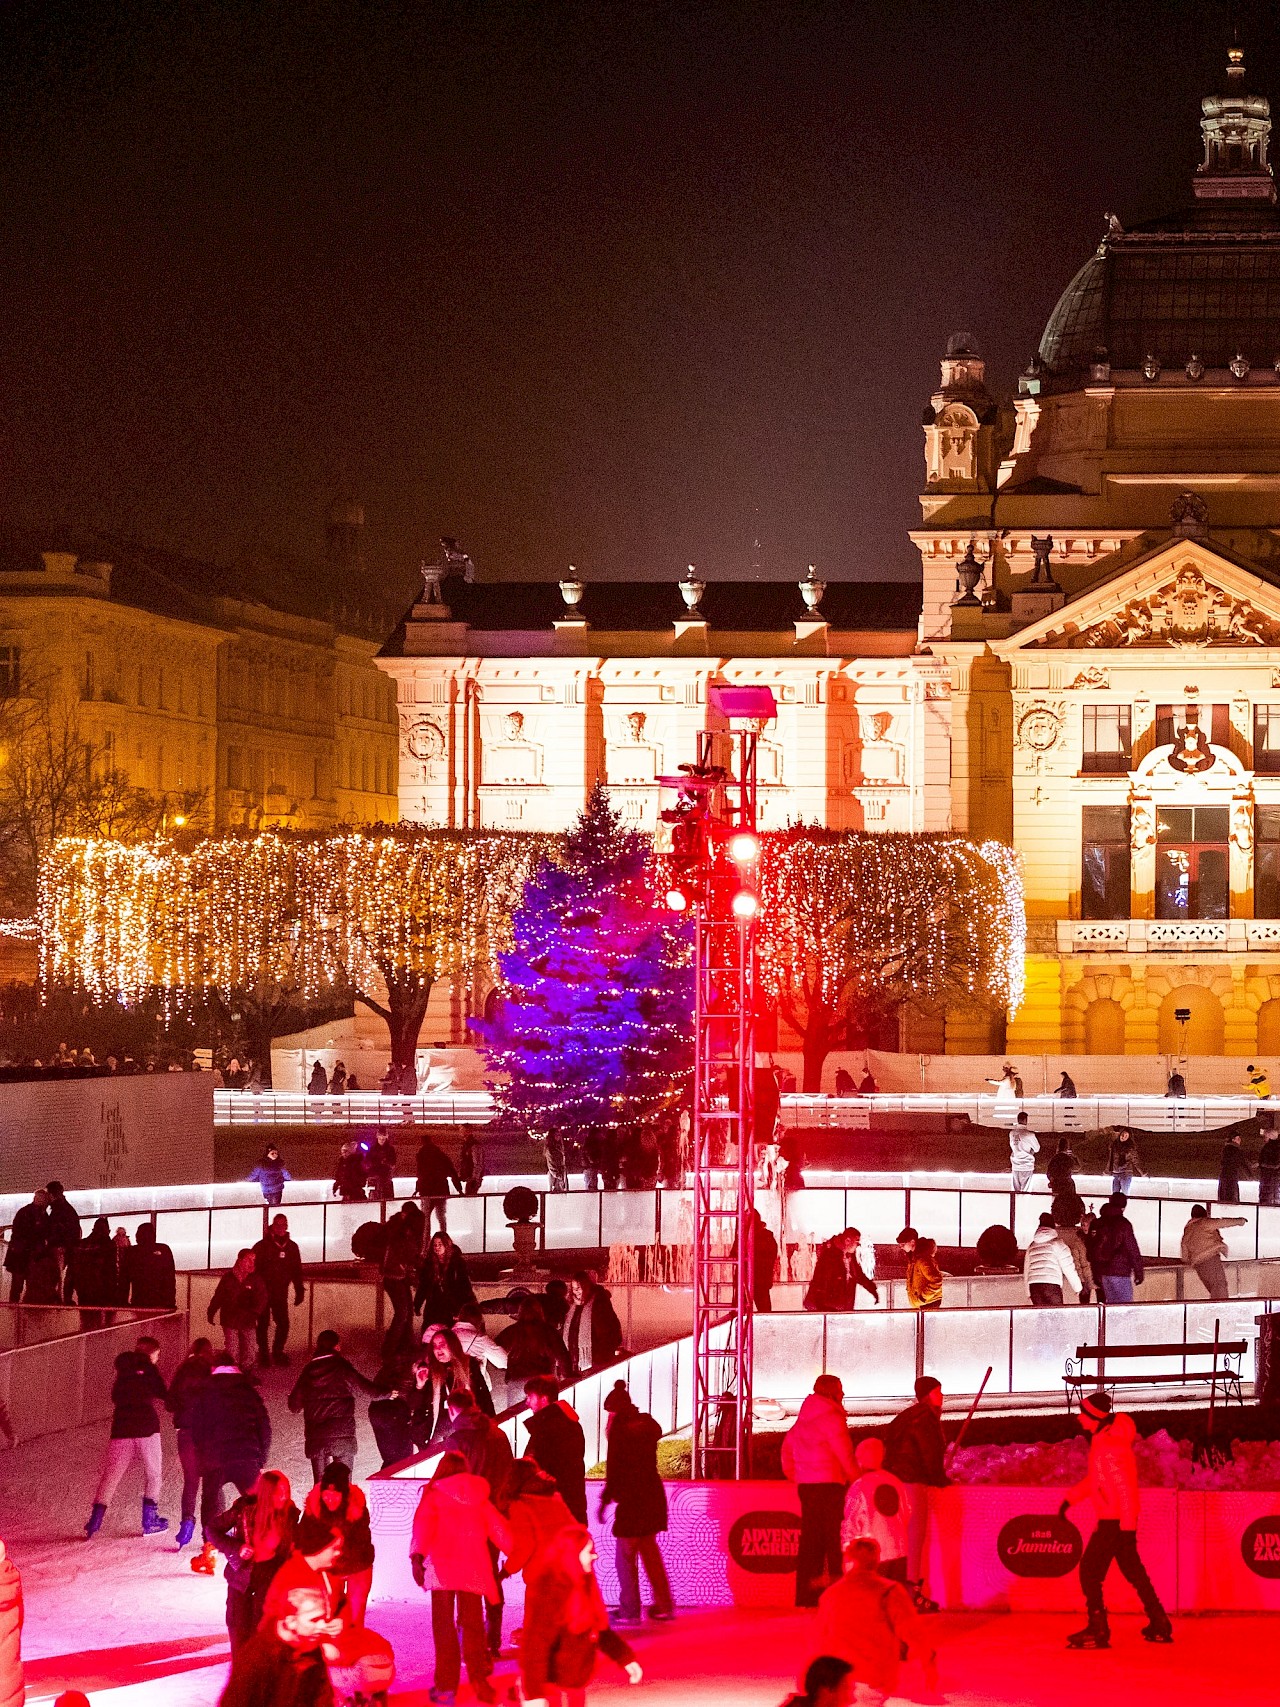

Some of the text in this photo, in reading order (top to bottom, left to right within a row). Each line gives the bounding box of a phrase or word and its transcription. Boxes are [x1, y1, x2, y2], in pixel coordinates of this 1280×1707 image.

[741, 1528, 802, 1542] ADVENT
[1031, 1530, 1052, 1538] 1828
[1006, 1538, 1073, 1555] Jamnica
